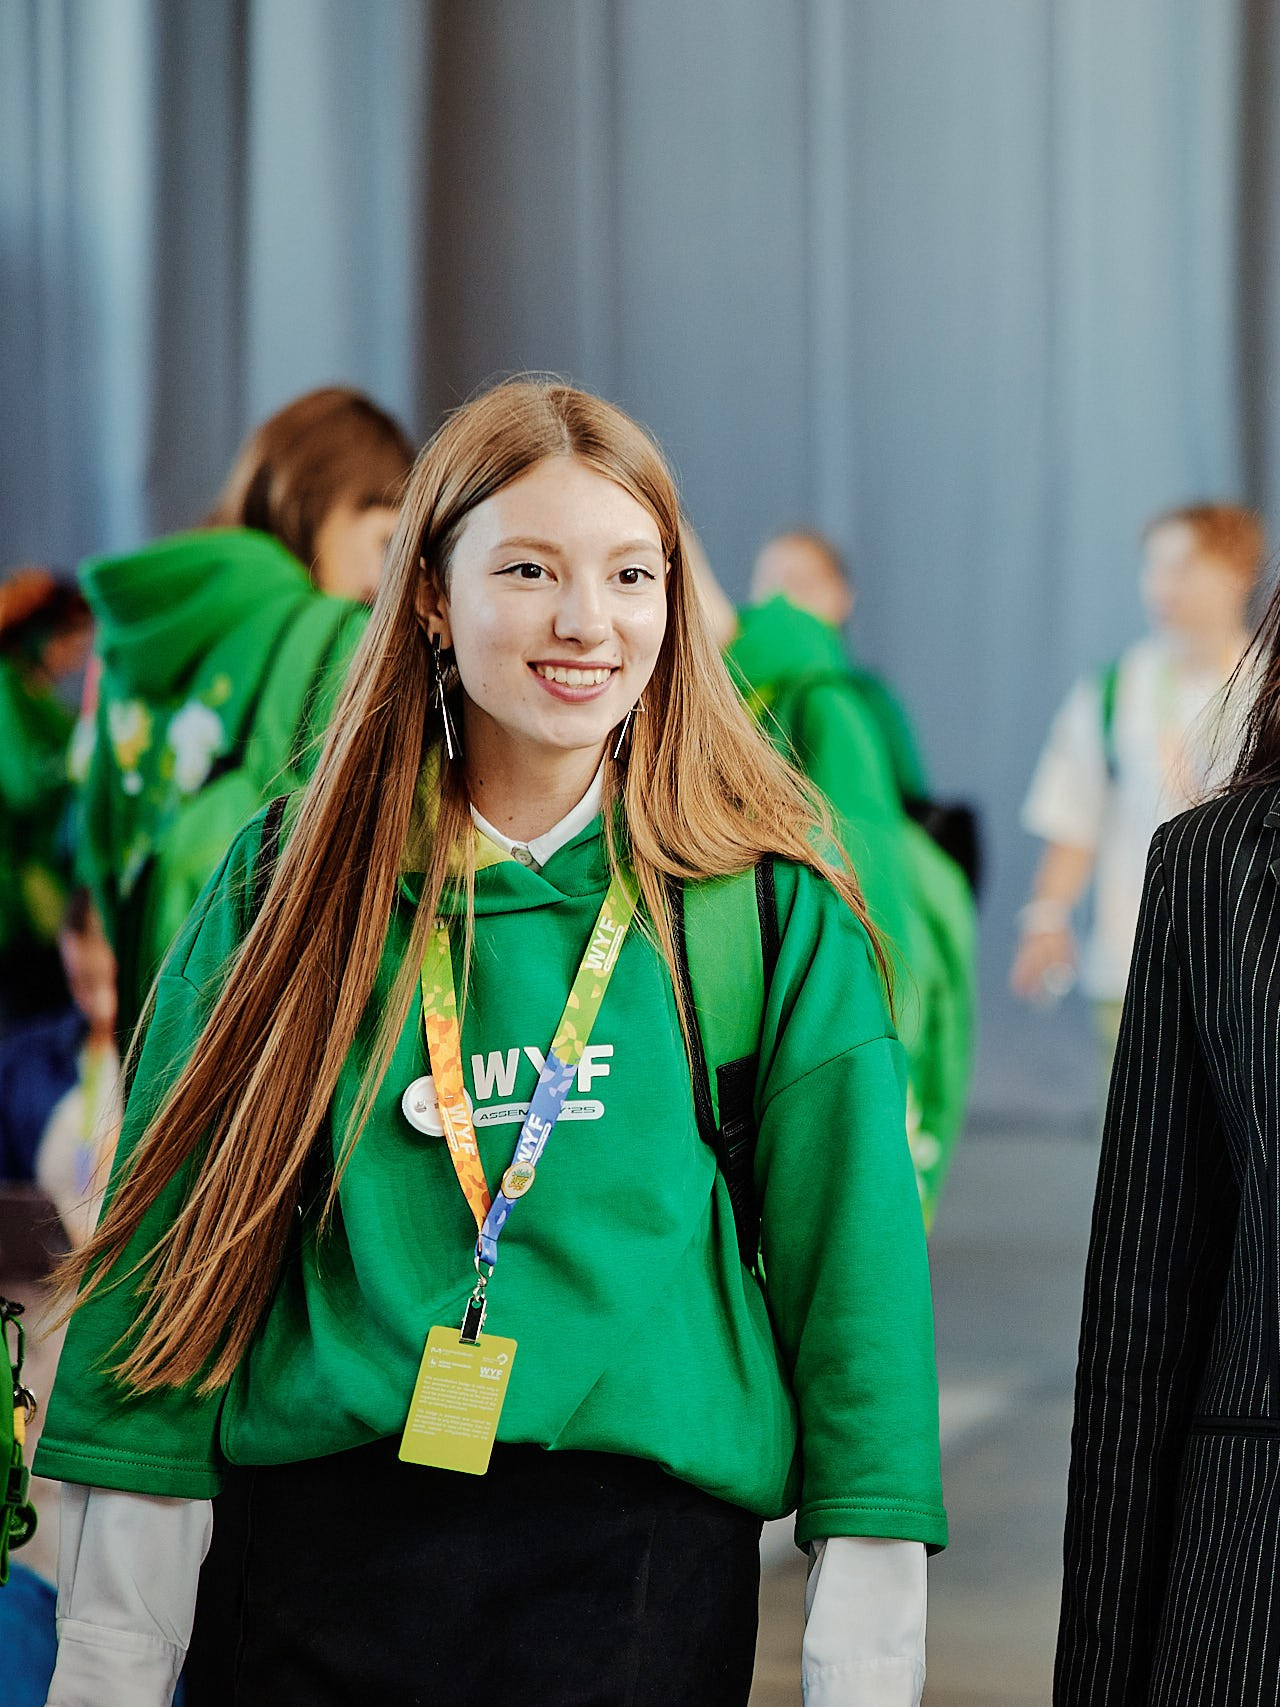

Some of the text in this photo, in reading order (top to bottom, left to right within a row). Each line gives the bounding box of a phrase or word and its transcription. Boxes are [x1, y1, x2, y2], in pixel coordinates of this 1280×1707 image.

[584, 915, 616, 969] WYF
[447, 1103, 476, 1156] WYF
[480, 1366, 503, 1377] WYF
